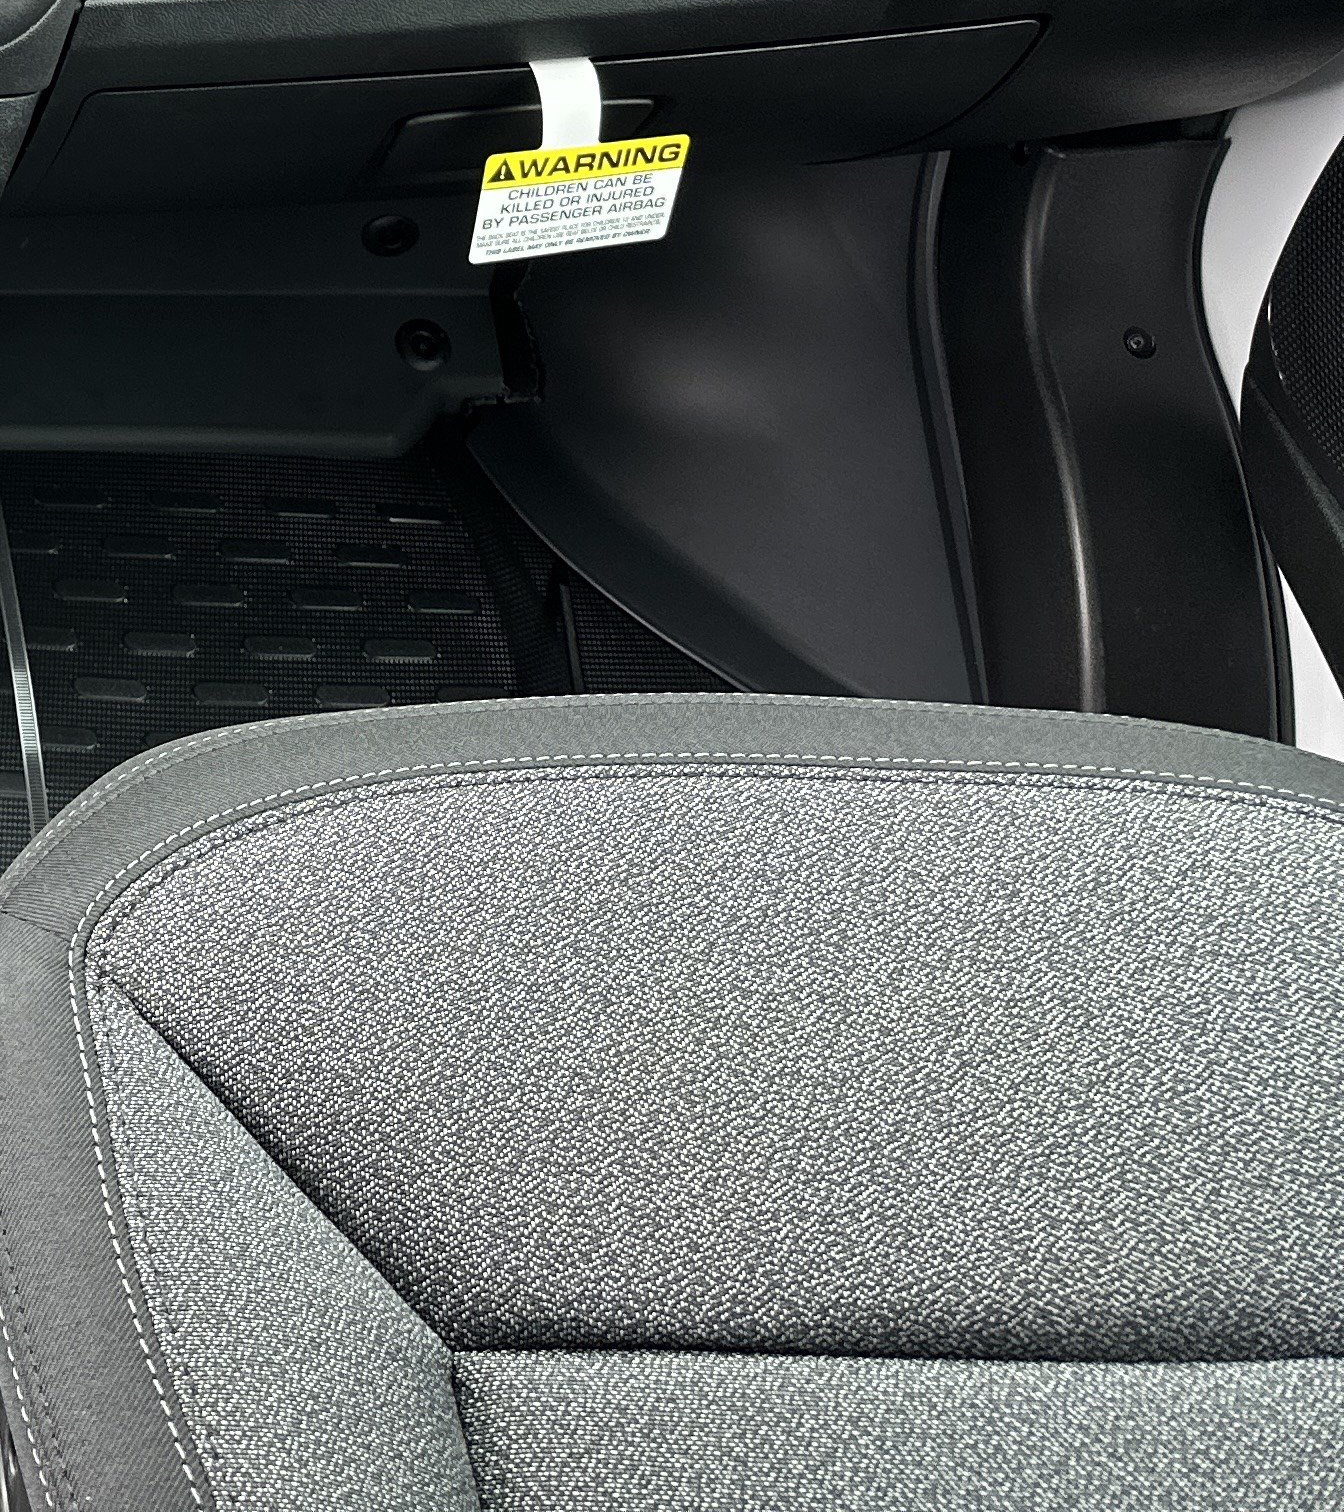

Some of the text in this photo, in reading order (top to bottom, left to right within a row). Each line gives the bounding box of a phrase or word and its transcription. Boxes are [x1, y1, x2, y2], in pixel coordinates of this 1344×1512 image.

[518, 142, 682, 180] WARNING
[500, 185, 655, 214] KILLED OR INJURED
[507, 172, 654, 201] CHILDREN CAN BE
[482, 196, 667, 230] BY PASSENGER AIRBAG
